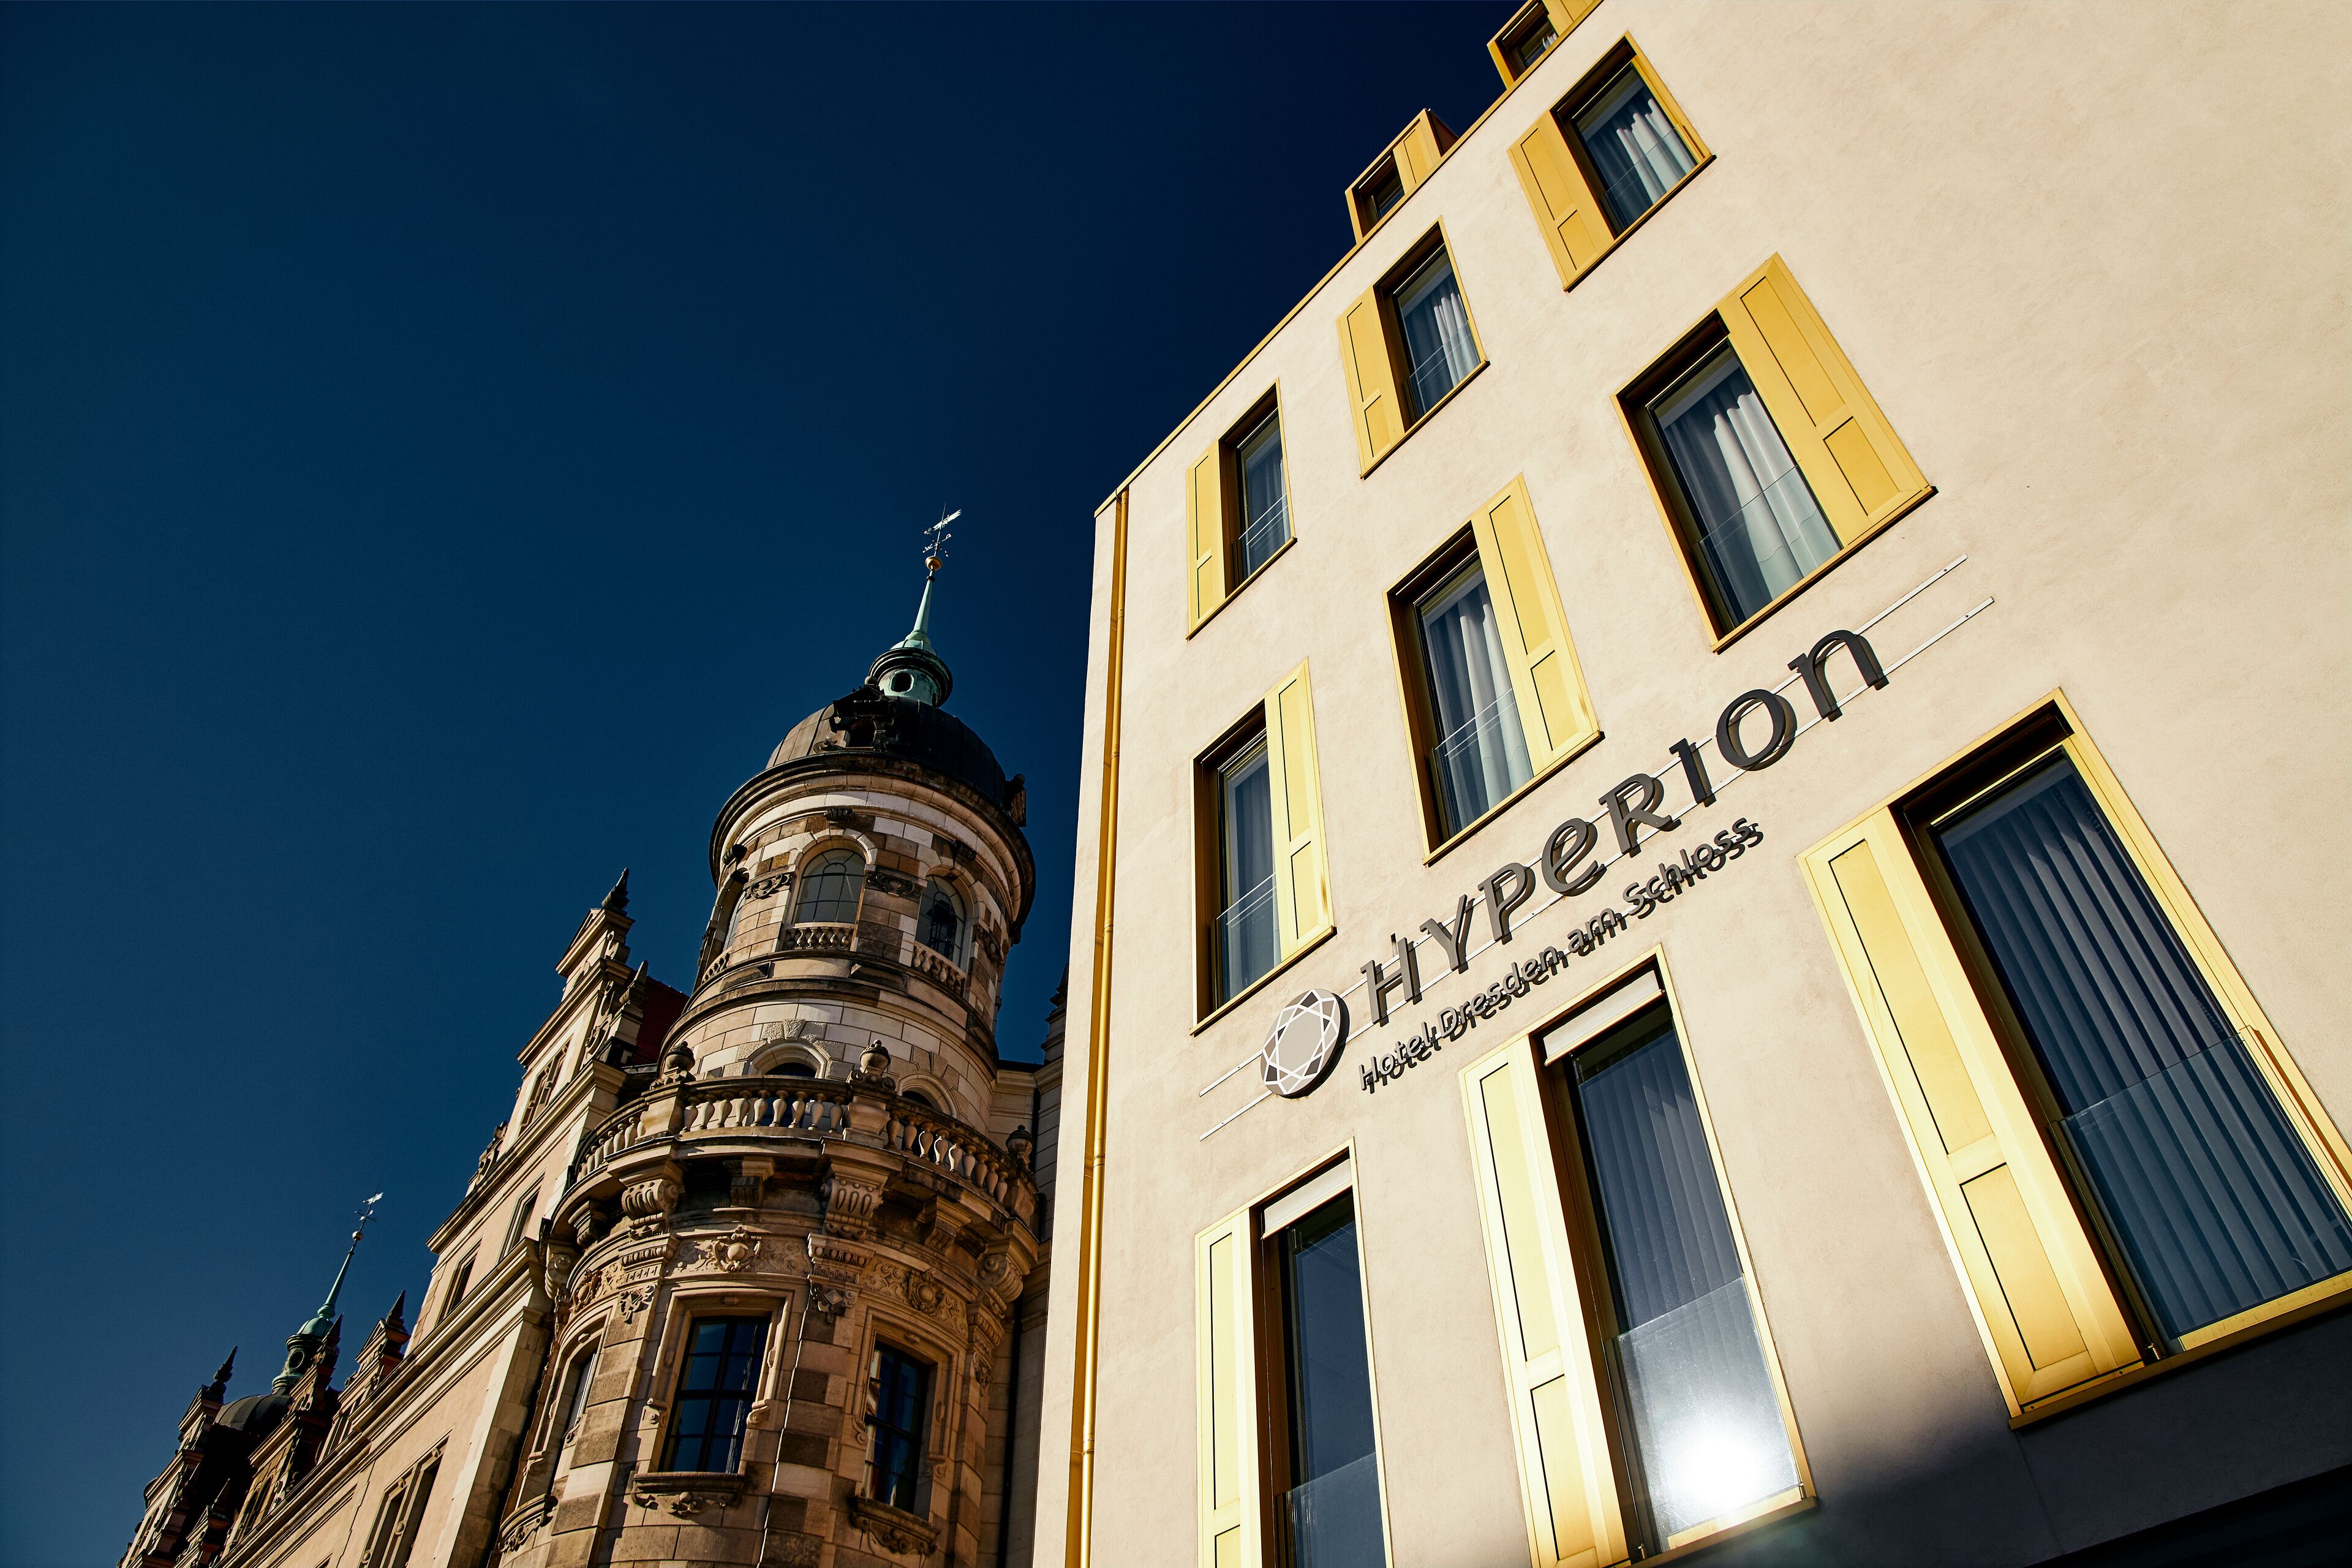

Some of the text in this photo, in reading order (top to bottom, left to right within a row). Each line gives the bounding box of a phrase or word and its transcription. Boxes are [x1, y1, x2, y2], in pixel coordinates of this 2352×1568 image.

[1359, 817, 1753, 1091] Hotel Dresden am Schloss
